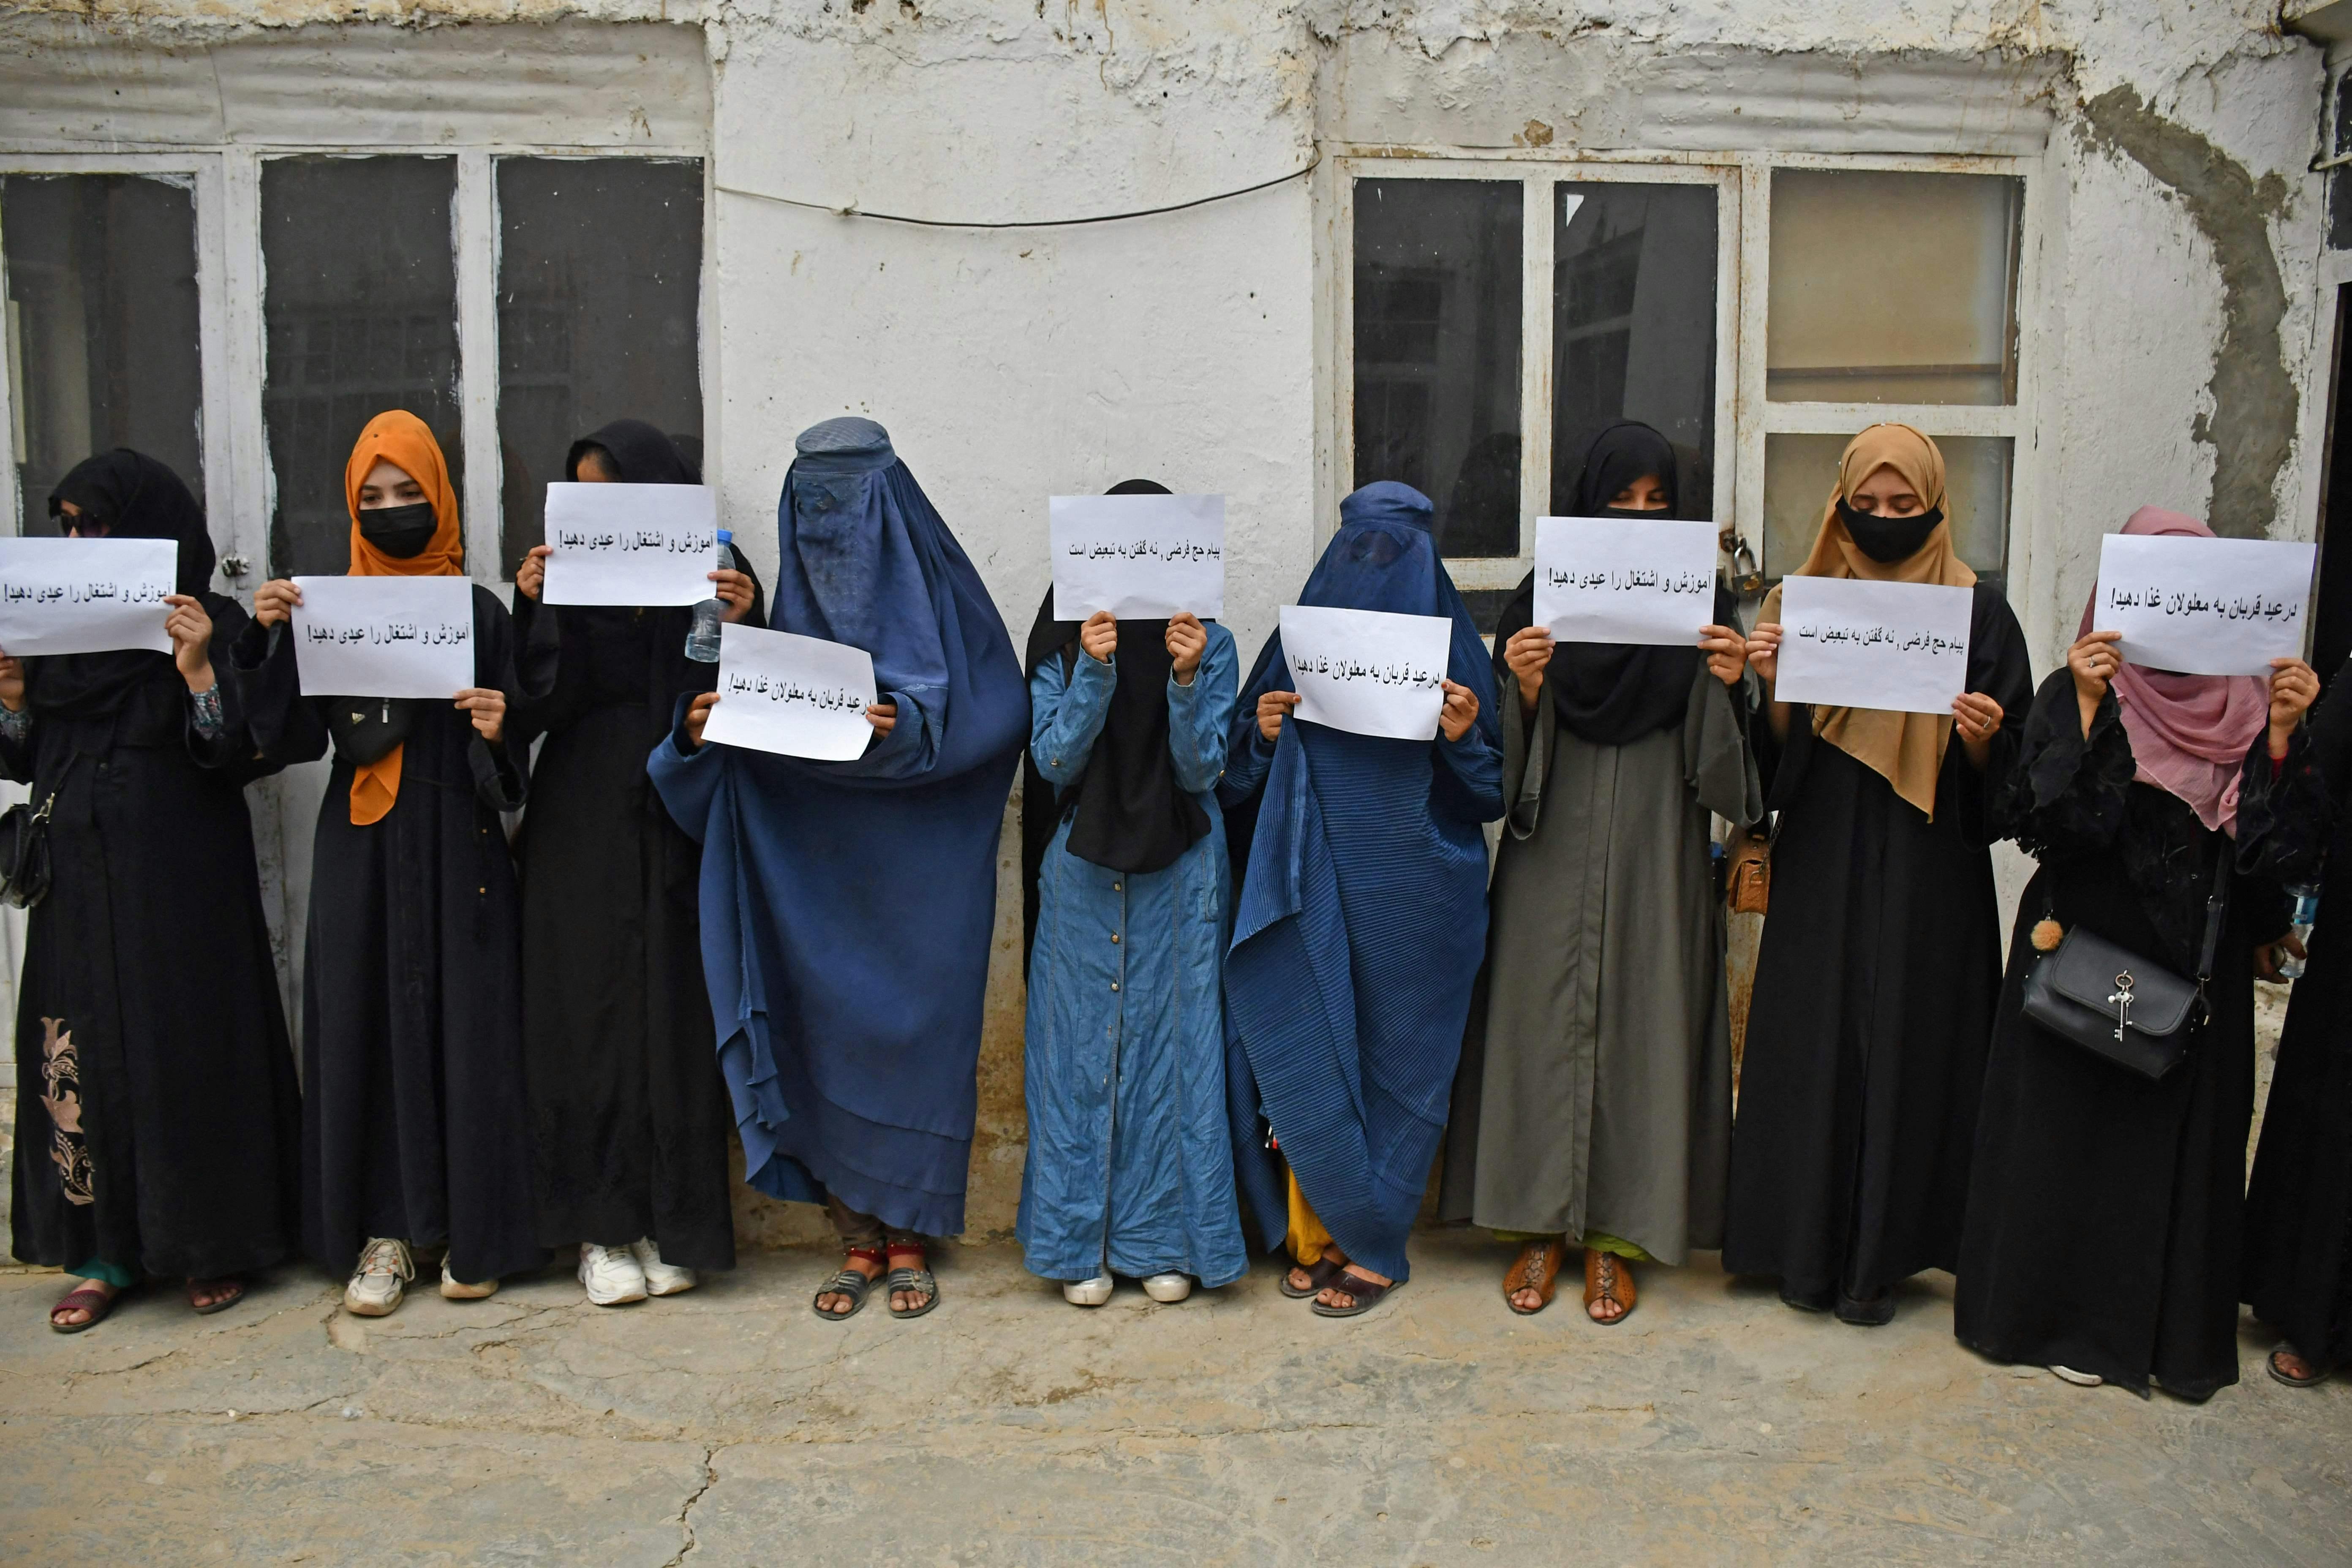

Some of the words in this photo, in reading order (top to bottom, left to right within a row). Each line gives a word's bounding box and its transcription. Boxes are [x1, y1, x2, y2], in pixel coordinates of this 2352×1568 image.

[588, 534, 614, 551] عیدی
[619, 532, 629, 552] را
[632, 531, 664, 551] اشتغال
[667, 538, 675, 553] و
[678, 531, 713, 553] آموزش
[1069, 543, 1086, 556] است
[1089, 542, 1116, 560] تبعیض
[1129, 539, 1147, 560] گفتن
[1149, 541, 1158, 555] نه
[1118, 544, 1127, 559] به
[1192, 546, 1205, 562] حج
[1206, 542, 1220, 561] پیام
[1579, 572, 1606, 590] عیدی
[1612, 570, 1621, 591] را
[1625, 569, 1658, 591] اشتغال
[1662, 578, 1670, 593] و
[1673, 570, 1712, 594] آموزش
[36, 587, 64, 604] عیدی
[69, 584, 80, 603] را
[83, 582, 117, 603] اشتغال
[121, 589, 129, 603] و
[2144, 586, 2161, 608] غذا
[2166, 592, 2209, 617] معلولان
[2213, 596, 2226, 619] به
[2228, 593, 2262, 621] قربان
[338, 628, 365, 645] عیدی
[370, 626, 381, 645] را
[384, 623, 417, 644] اشتغال
[421, 630, 429, 645] و
[432, 622, 469, 645] آموزش
[1799, 625, 1817, 639] است
[1820, 626, 1849, 645] تبعیض
[1851, 629, 1860, 645] به
[1862, 626, 1883, 647] گفتن
[1884, 629, 1895, 644] نه
[1932, 638, 1946, 655] حج
[1949, 636, 1964, 656] پیام
[1316, 654, 1329, 674] غذا
[1332, 659, 1367, 681] معلولان
[1369, 663, 1380, 683] به
[1383, 662, 1409, 686] قربان
[754, 675, 768, 694] غذا
[771, 681, 804, 703] معلولان
[807, 688, 817, 708] به
[819, 687, 844, 711] قربان
